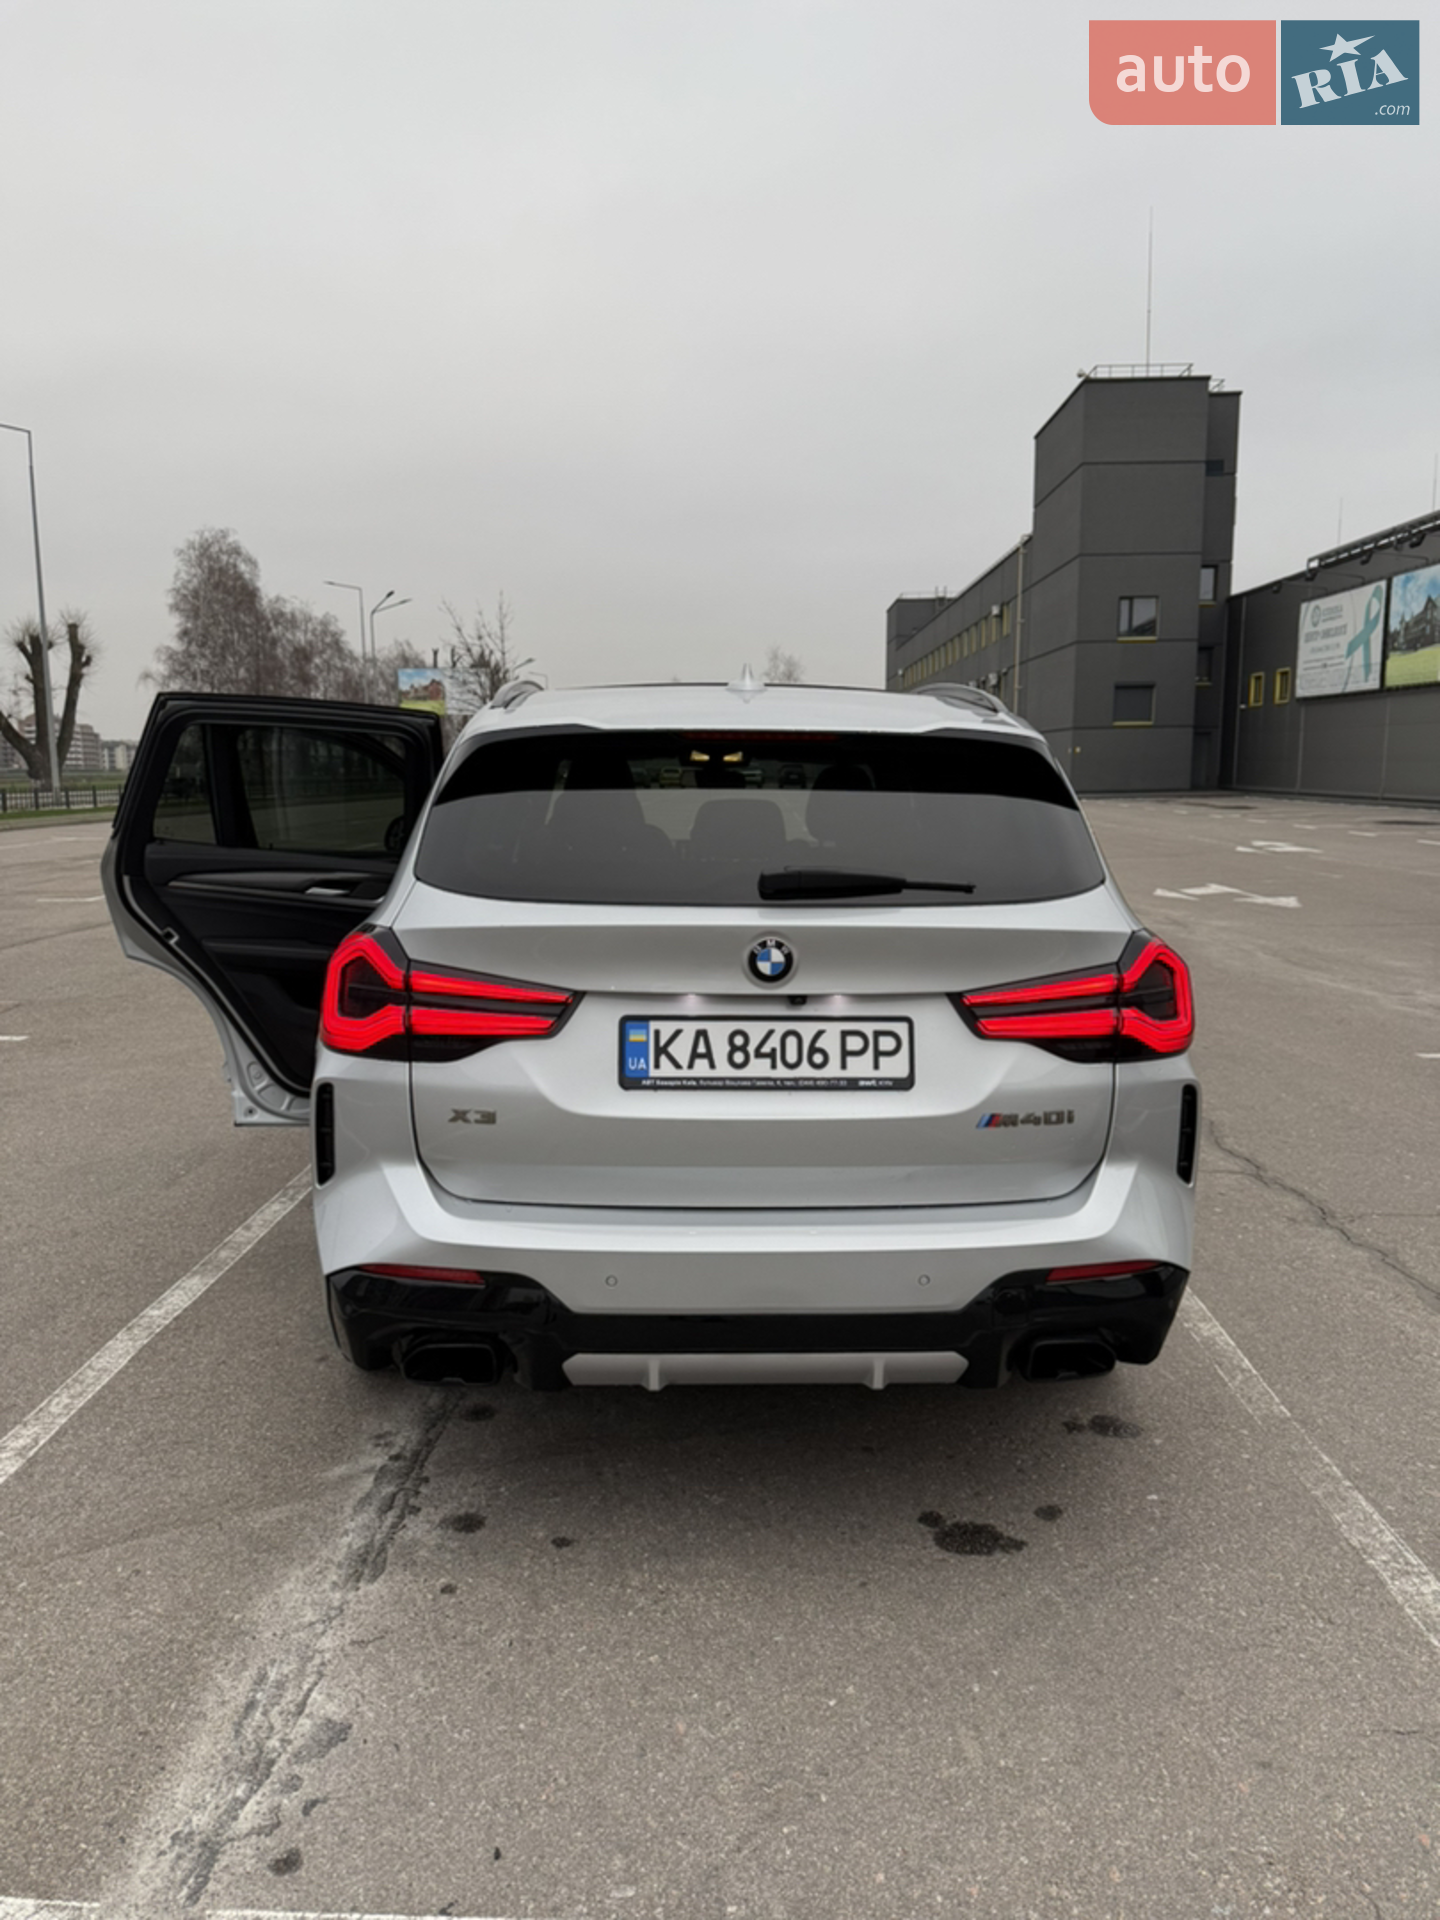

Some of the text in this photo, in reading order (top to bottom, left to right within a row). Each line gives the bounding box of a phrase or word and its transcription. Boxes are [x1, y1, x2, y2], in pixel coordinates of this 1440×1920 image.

[653, 1028, 903, 1071] KA 8406 PP
[628, 1056, 648, 1071] UA
[447, 1108, 497, 1125] X3
